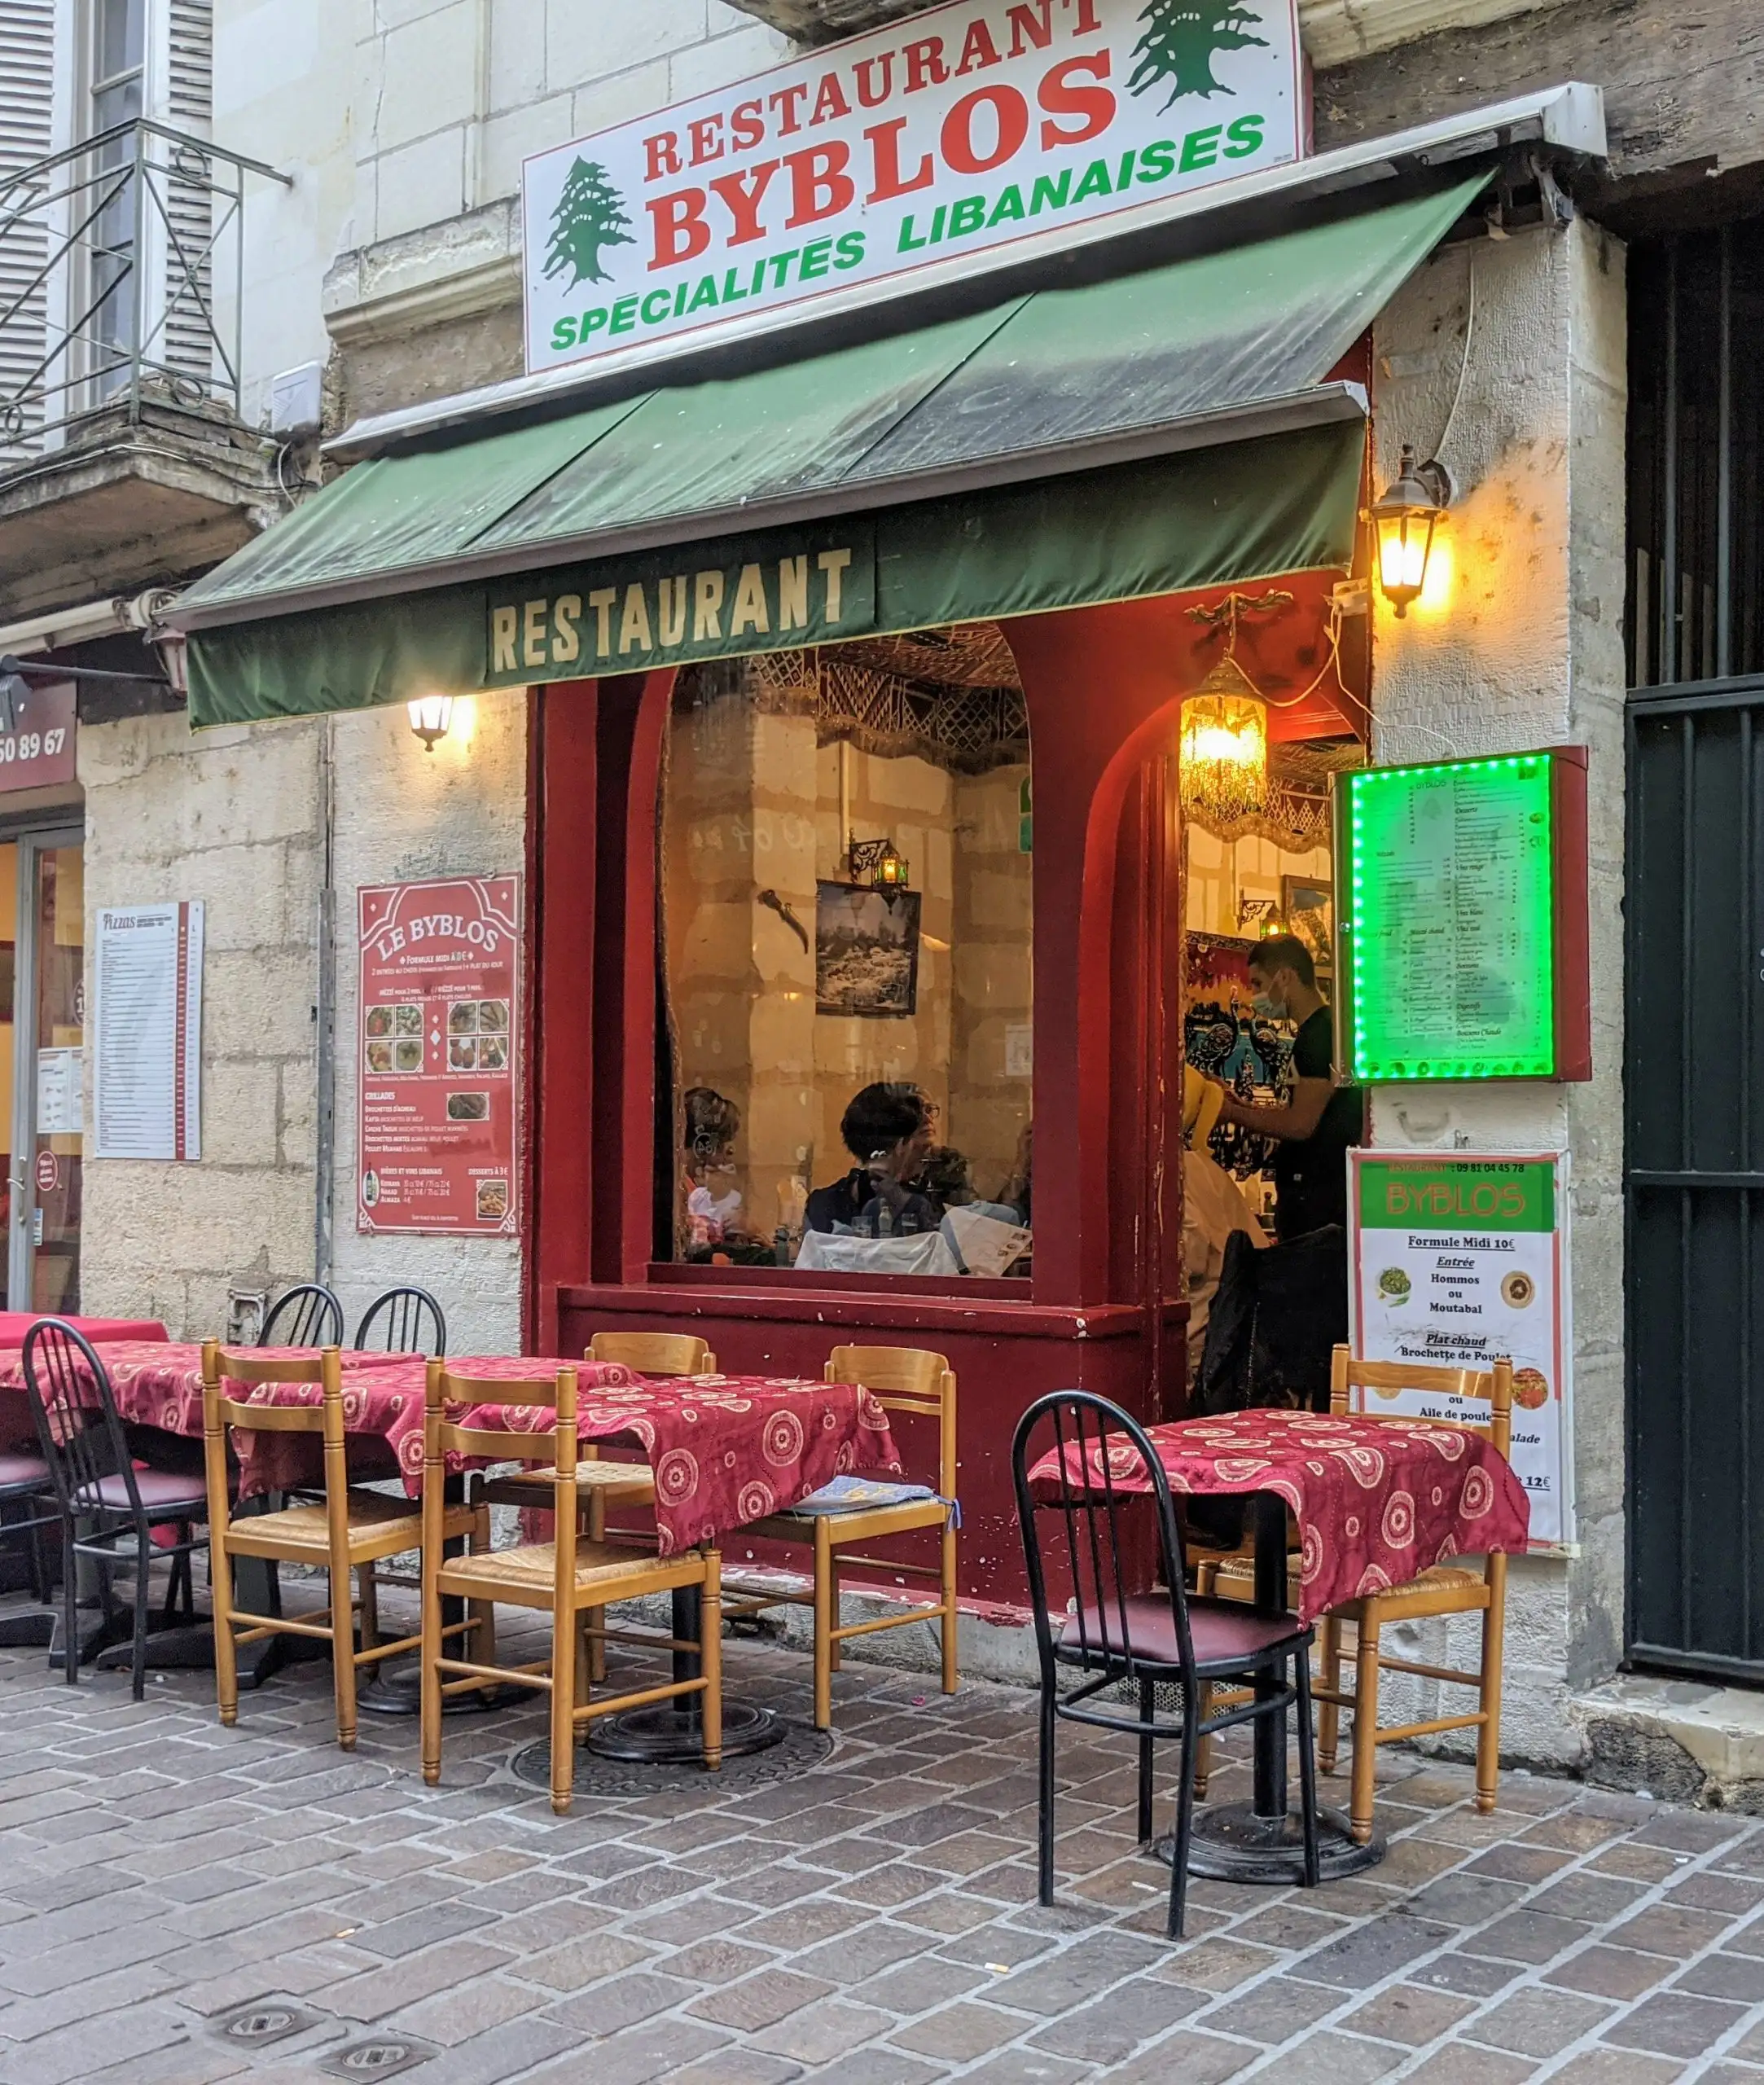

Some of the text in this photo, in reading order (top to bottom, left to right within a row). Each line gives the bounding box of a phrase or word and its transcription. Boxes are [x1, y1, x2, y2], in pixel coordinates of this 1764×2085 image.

[643, 0, 1102, 182] RESTAURANT
[645, 48, 1117, 271] BYBLOS
[897, 113, 1266, 252] LIBANAISES
[494, 548, 852, 673] RESTAURANT
[20, 732, 41, 760] 89
[44, 727, 65, 756] 67
[103, 913, 137, 930] Pizzas
[376, 915, 499, 961] LE BYBLOS
[1456, 1163, 1468, 1173] 09
[1470, 1163, 1481, 1173] 81
[1484, 1163, 1495, 1173] 04
[1498, 1163, 1510, 1173] 45
[1512, 1163, 1525, 1173] 78
[1388, 1183, 1525, 1217] BYBLOS
[1408, 1236, 1516, 1249] Formule Midi 10€
[1437, 1257, 1475, 1267] Entrée
[1431, 1274, 1480, 1284] Hommos
[1448, 1290, 1463, 1298] ou
[1429, 1302, 1483, 1315] Moutabal
[1426, 1333, 1487, 1347] Plat chaud
[1401, 1347, 1456, 1359] Brochette
[1459, 1350, 1472, 1360] de
[1448, 1396, 1463, 1404] ou
[1420, 1407, 1442, 1418] Aile
[1445, 1409, 1458, 1419] de
[1508, 1433, 1541, 1444] alade
[1525, 1476, 1551, 1488] 12€
